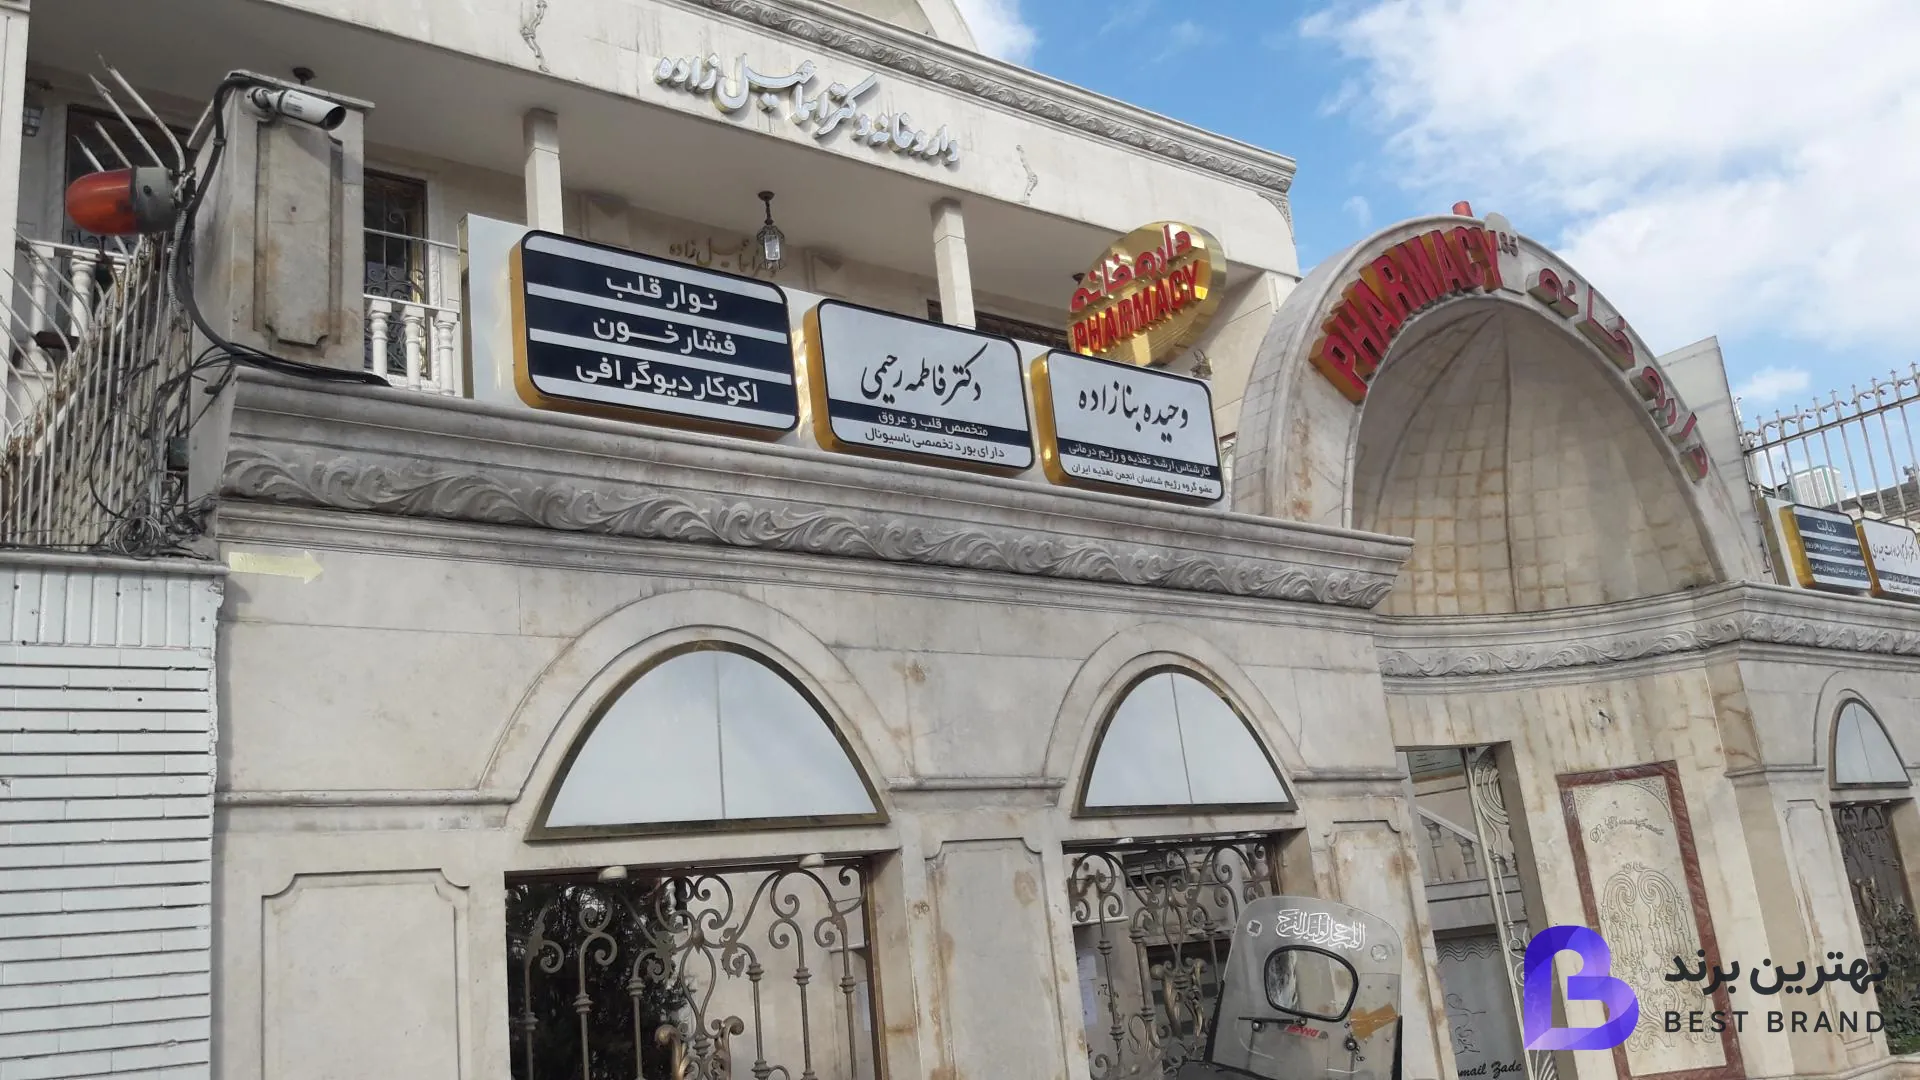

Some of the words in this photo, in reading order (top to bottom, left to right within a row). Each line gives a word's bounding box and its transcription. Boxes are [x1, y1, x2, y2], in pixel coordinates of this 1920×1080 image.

[653, 52, 720, 92] زاده
[815, 73, 878, 138] دکتر
[869, 112, 959, 165] داروخانه
[1070, 224, 1192, 312] داروخانه
[605, 274, 663, 300] قلب
[665, 285, 719, 316] نوار
[1073, 259, 1200, 353] PHARMACY
[1312, 226, 1503, 401] PHARMACY
[592, 316, 681, 344] خون
[680, 327, 738, 357] فشار
[860, 354, 903, 404] رحیمی
[904, 357, 948, 397] فاطمه
[940, 342, 989, 406] دکتر
[1531, 267, 1710, 483] داروخانه
[878, 411, 908, 426] عروق
[911, 417, 917, 428] و
[920, 416, 943, 431] قلب
[944, 423, 989, 437] متخصص
[1143, 402, 1190, 443] وحیده
[865, 427, 911, 445] ناسیونال
[911, 438, 954, 451] تخصصی
[955, 443, 977, 457] بورد
[977, 445, 1006, 460] دارای
[1457, 1062, 1488, 1078] mail
